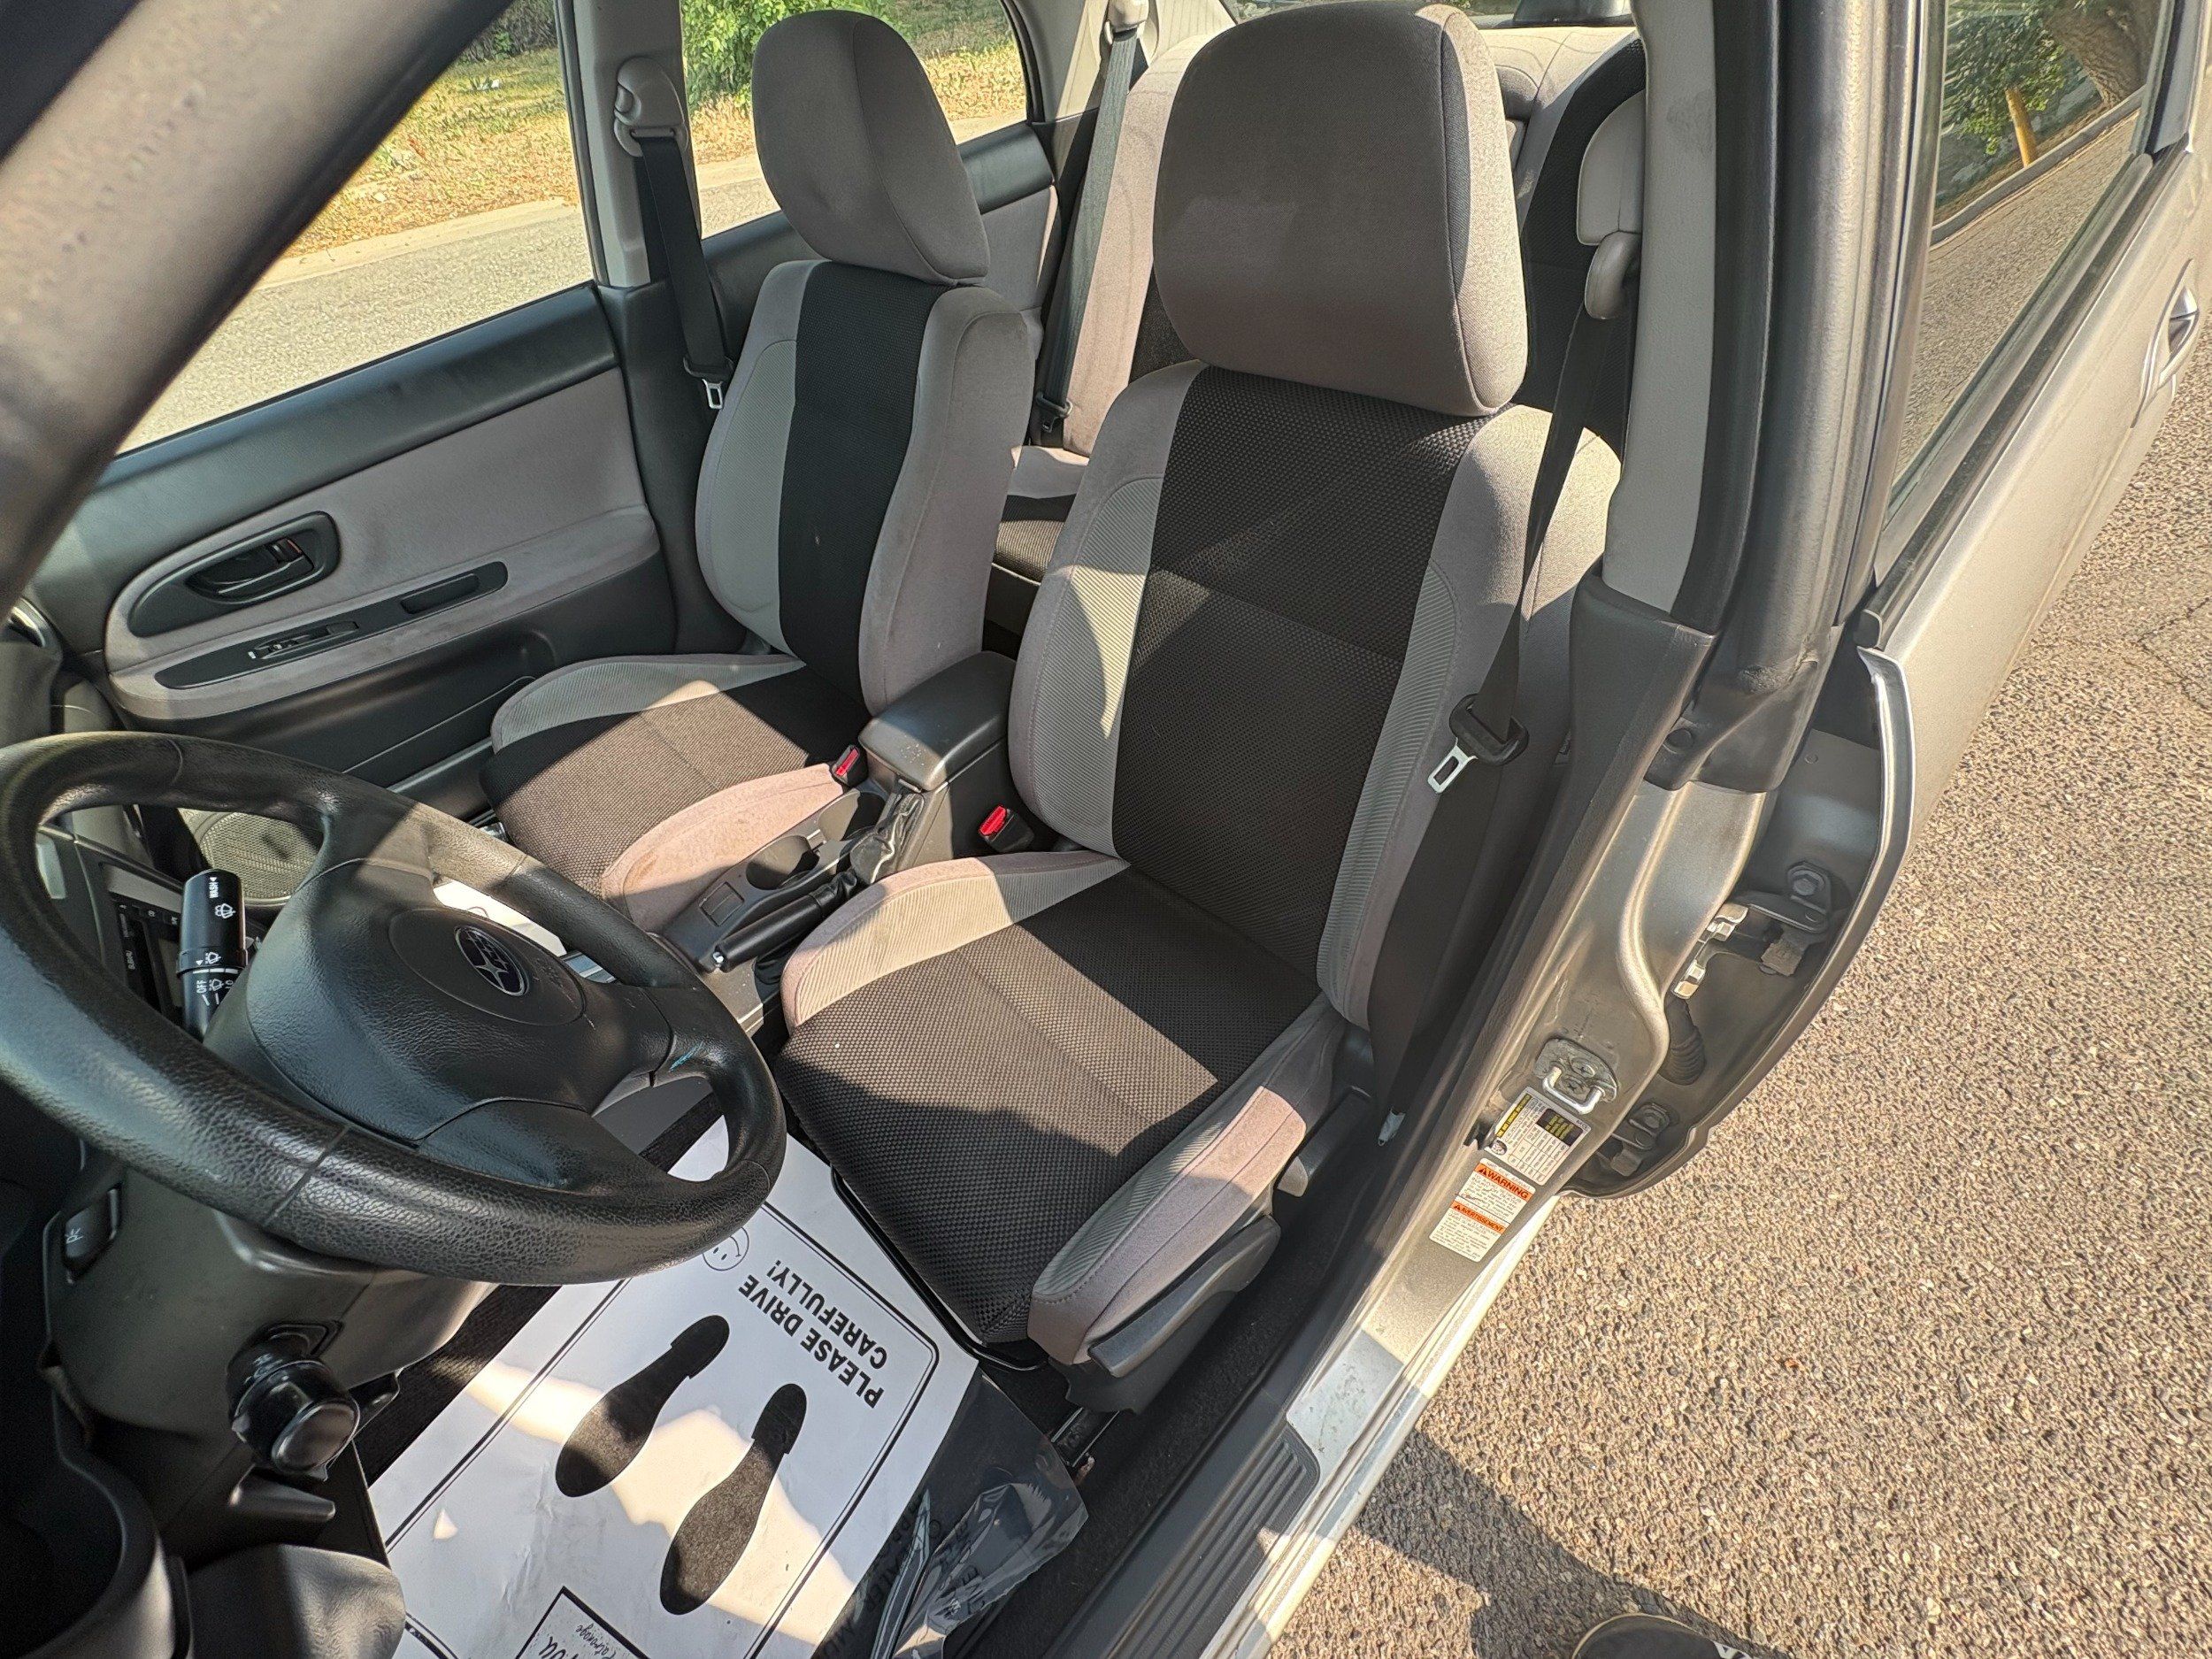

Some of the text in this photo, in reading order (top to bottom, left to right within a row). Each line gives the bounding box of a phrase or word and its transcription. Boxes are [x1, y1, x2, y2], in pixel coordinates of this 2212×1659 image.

[196, 979, 207, 993] OFF
[1487, 1170, 1529, 1200] WARNING
[1461, 1207, 1503, 1233] AVERTISSEMENT
[766, 1259, 887, 1370] CAREFULLY!
[738, 1274, 885, 1409] PLEASE DRIVE
